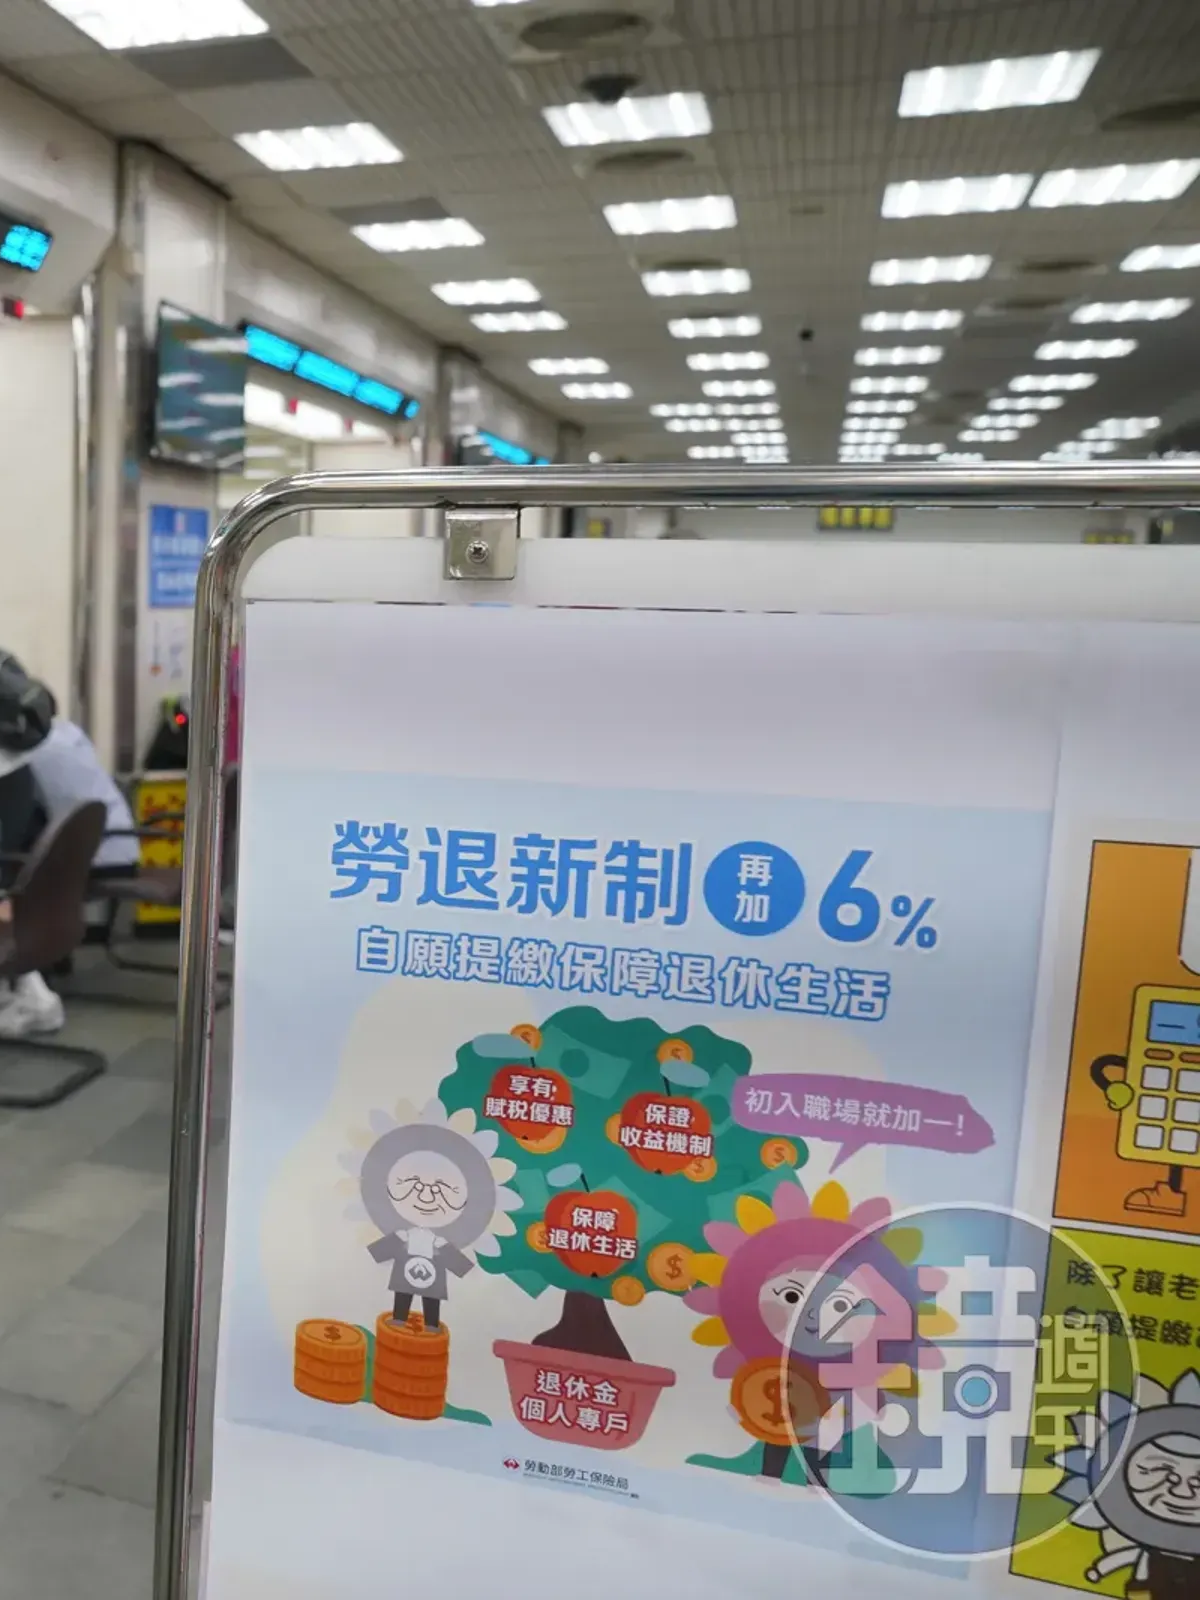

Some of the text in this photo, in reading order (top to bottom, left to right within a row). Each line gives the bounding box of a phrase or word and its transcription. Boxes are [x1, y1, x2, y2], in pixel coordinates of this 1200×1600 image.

[329, 819, 938, 949] 勞退新制 再加 6%
[356, 924, 891, 1022] 自願提繳保障退休生活
[509, 1074, 557, 1099] 享有
[645, 1102, 691, 1129] 保證
[620, 1126, 712, 1157] 收益機制
[571, 1206, 616, 1232] 保障
[548, 1228, 636, 1260] 退休生活
[1063, 1305, 1200, 1350] 自願提繳
[536, 1369, 619, 1407] 退休金
[520, 1396, 629, 1434] 個人專戶
